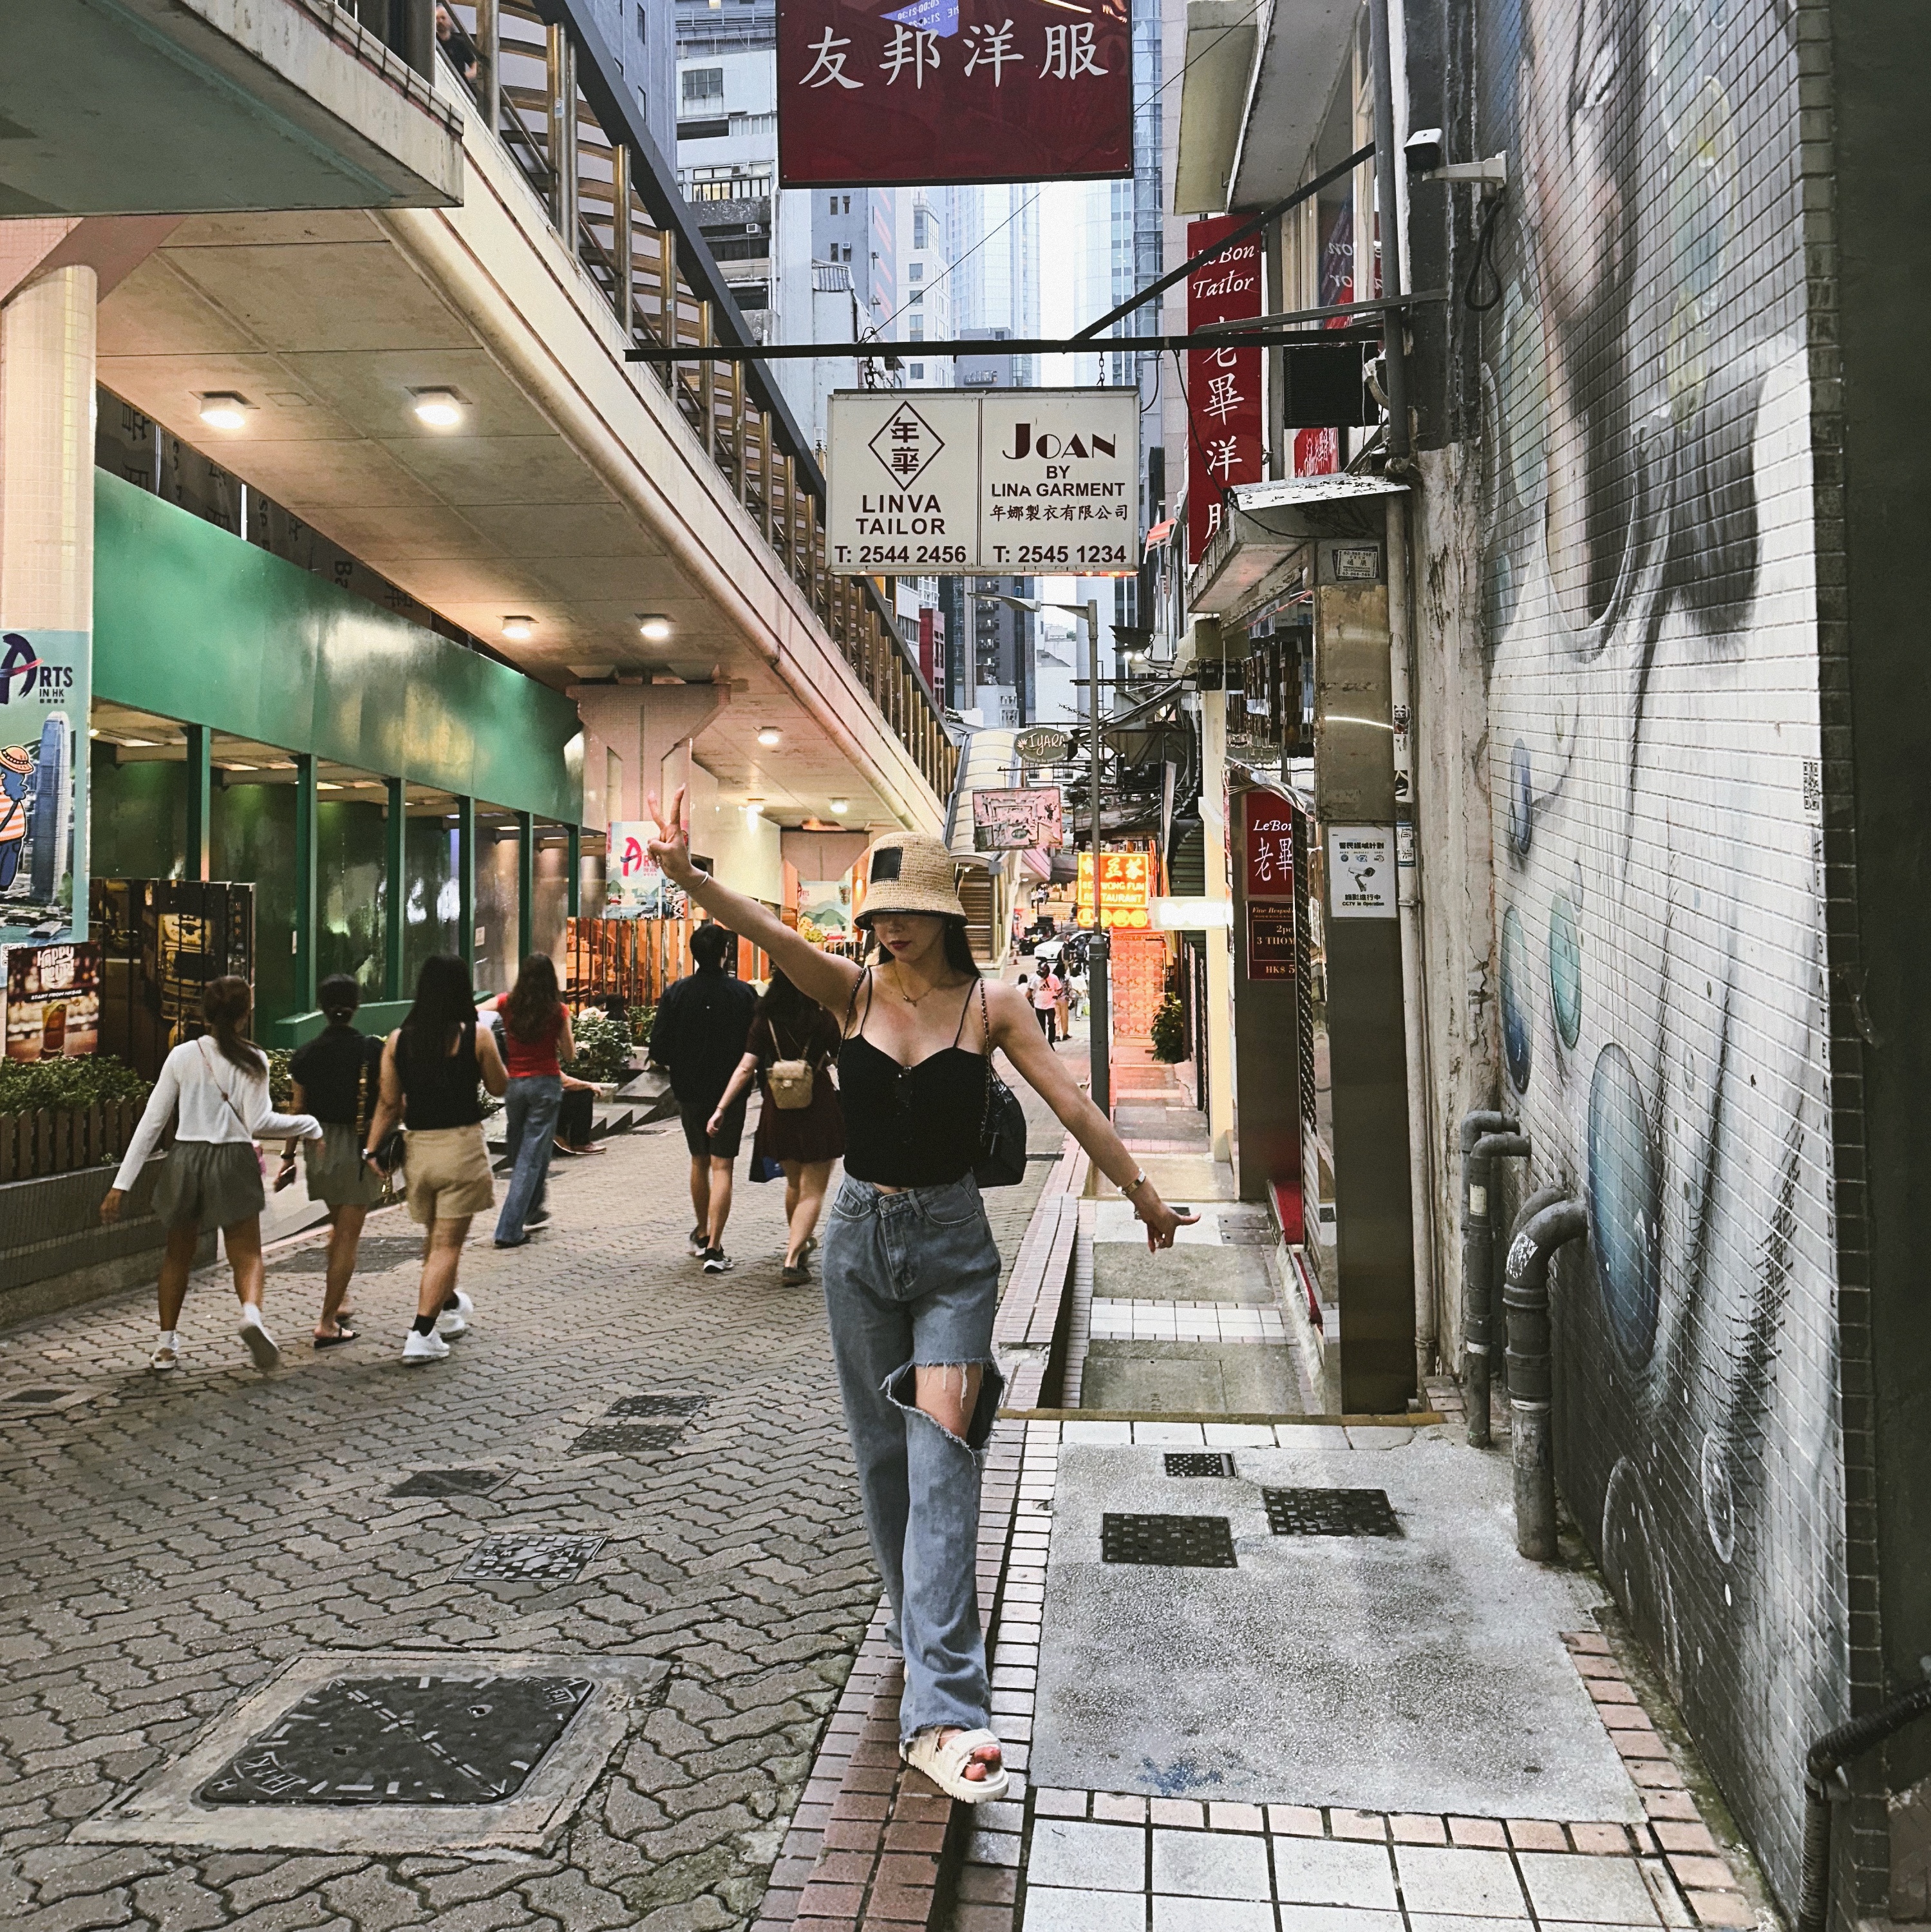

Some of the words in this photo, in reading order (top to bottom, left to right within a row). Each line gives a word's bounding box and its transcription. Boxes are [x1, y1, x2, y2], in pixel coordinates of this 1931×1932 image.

[799, 19, 1108, 89] 友邦洋服
[1193, 270, 1254, 298] Tailor
[1002, 423, 1116, 459] JOAN
[1047, 465, 1070, 479] BY
[992, 483, 1031, 497] LINA
[1036, 482, 1126, 497] GARMENT
[862, 495, 941, 513] LINVA
[990, 504, 1128, 522] 年娜製衣有限公司
[856, 518, 946, 535] TAILOR
[834, 545, 852, 563] T:
[860, 545, 909, 563] 2544
[916, 545, 966, 563] 2456
[993, 545, 1011, 563] T:
[1018, 545, 1069, 563] 2545
[1077, 545, 1126, 563] 1234
[0, 633, 73, 705] ARTS
[39, 688, 49, 697] IN
[52, 688, 64, 697] HK
[1100, 881, 1126, 890] WONG
[1126, 882, 1145, 891] FUN
[1084, 892, 1143, 903] RETAURANT
[1257, 936, 1263, 945] 3
